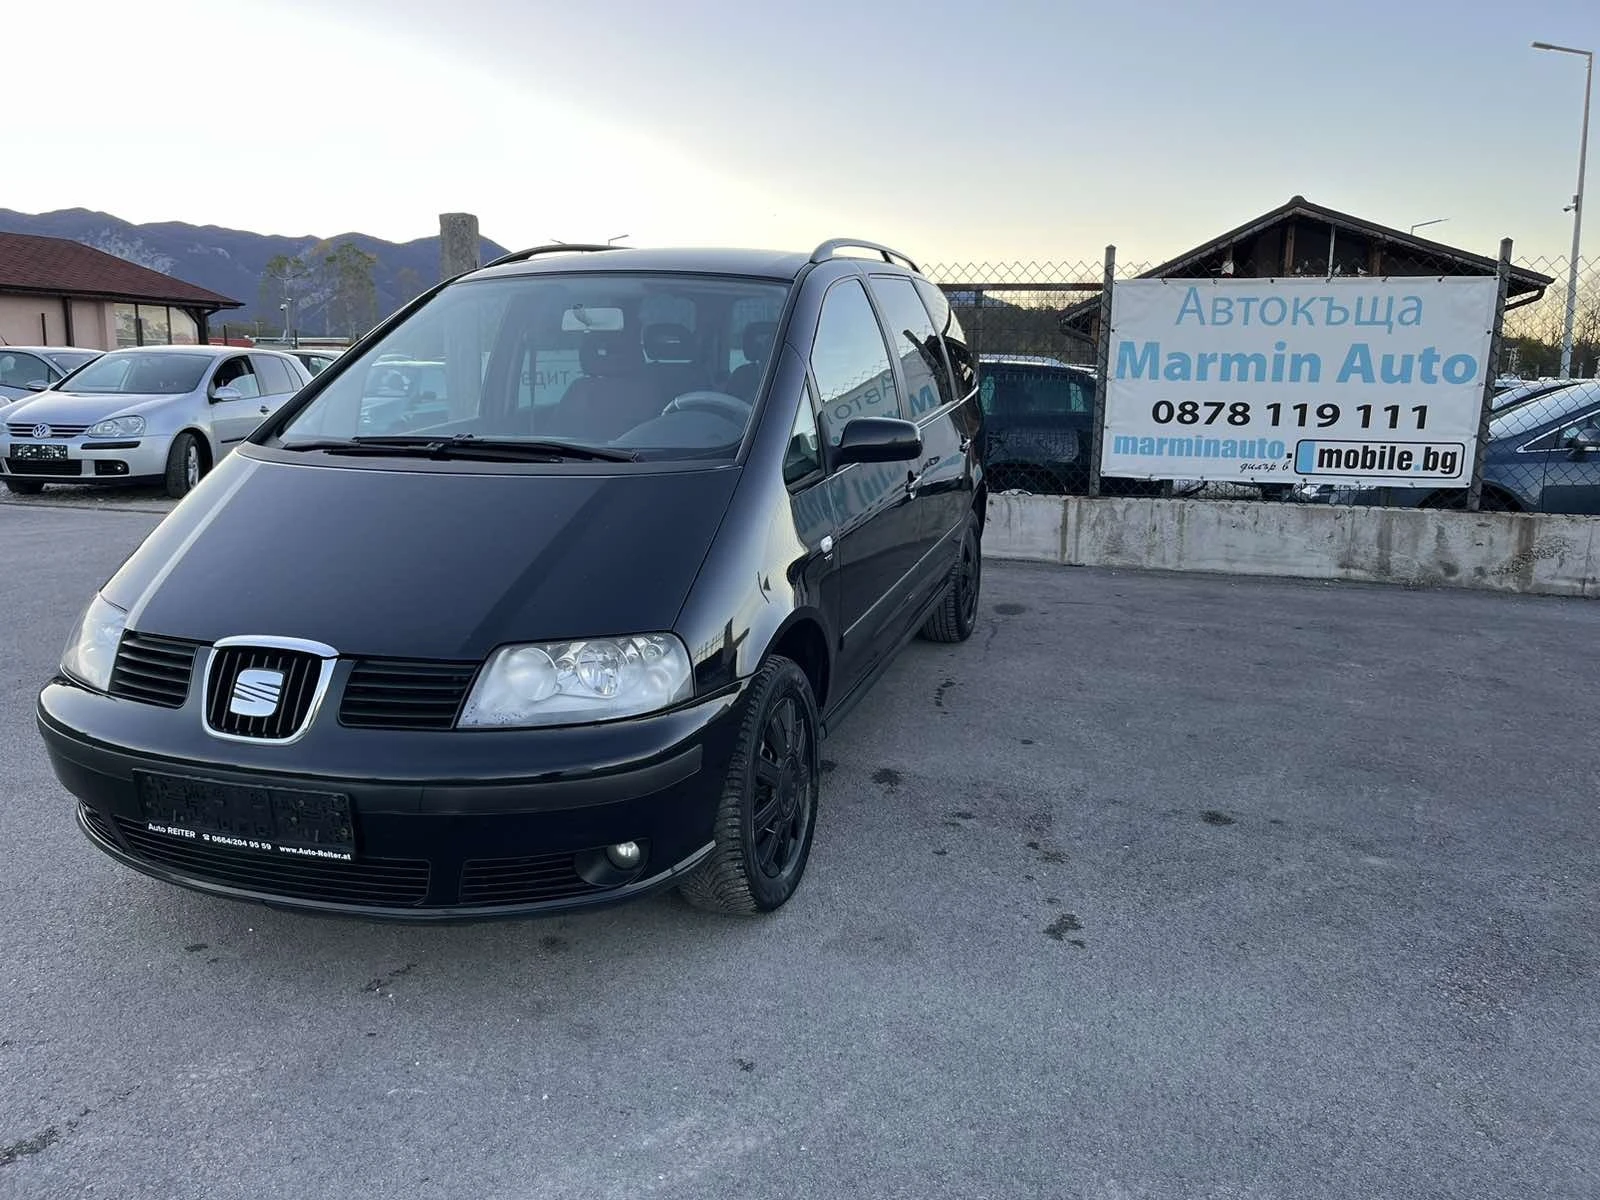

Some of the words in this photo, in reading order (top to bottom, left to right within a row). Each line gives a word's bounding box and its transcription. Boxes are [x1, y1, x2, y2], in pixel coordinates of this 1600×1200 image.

[1175, 286, 1423, 334] Автокъща
[1115, 340, 1322, 384] Marmin
[1336, 343, 1478, 385] Auto
[1151, 400, 1251, 426] 0878
[1266, 403, 1340, 428] 119
[1356, 404, 1428, 430] 111
[1317, 445, 1458, 473] mobile.bg
[148, 822, 167, 833] Auto
[167, 826, 196, 839] REITER
[279, 845, 352, 861] www.Auto-Reiter.at
